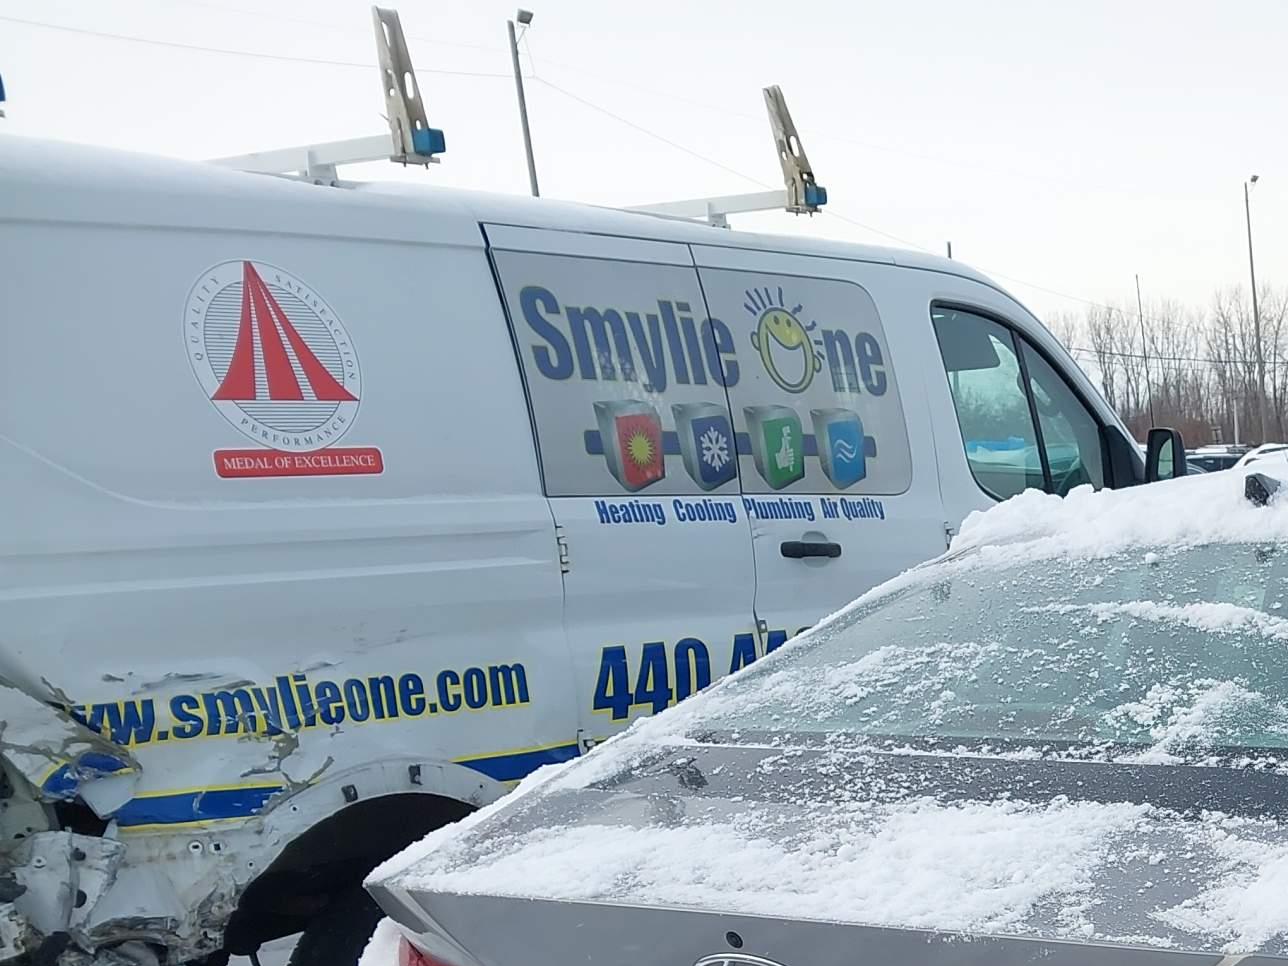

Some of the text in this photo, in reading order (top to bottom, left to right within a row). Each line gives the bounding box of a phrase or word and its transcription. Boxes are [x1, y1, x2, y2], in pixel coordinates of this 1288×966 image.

[191, 276, 220, 361] QUALITY
[274, 275, 356, 380] SATISFACTION
[519, 286, 740, 393] Smylie
[224, 455, 376, 470] MEDAL OF EXCELLENCE
[241, 415, 346, 445] PERFORMANCE
[594, 497, 885, 525] Heating Cooling Plumbing Air Quality
[593, 637, 711, 720] 440
